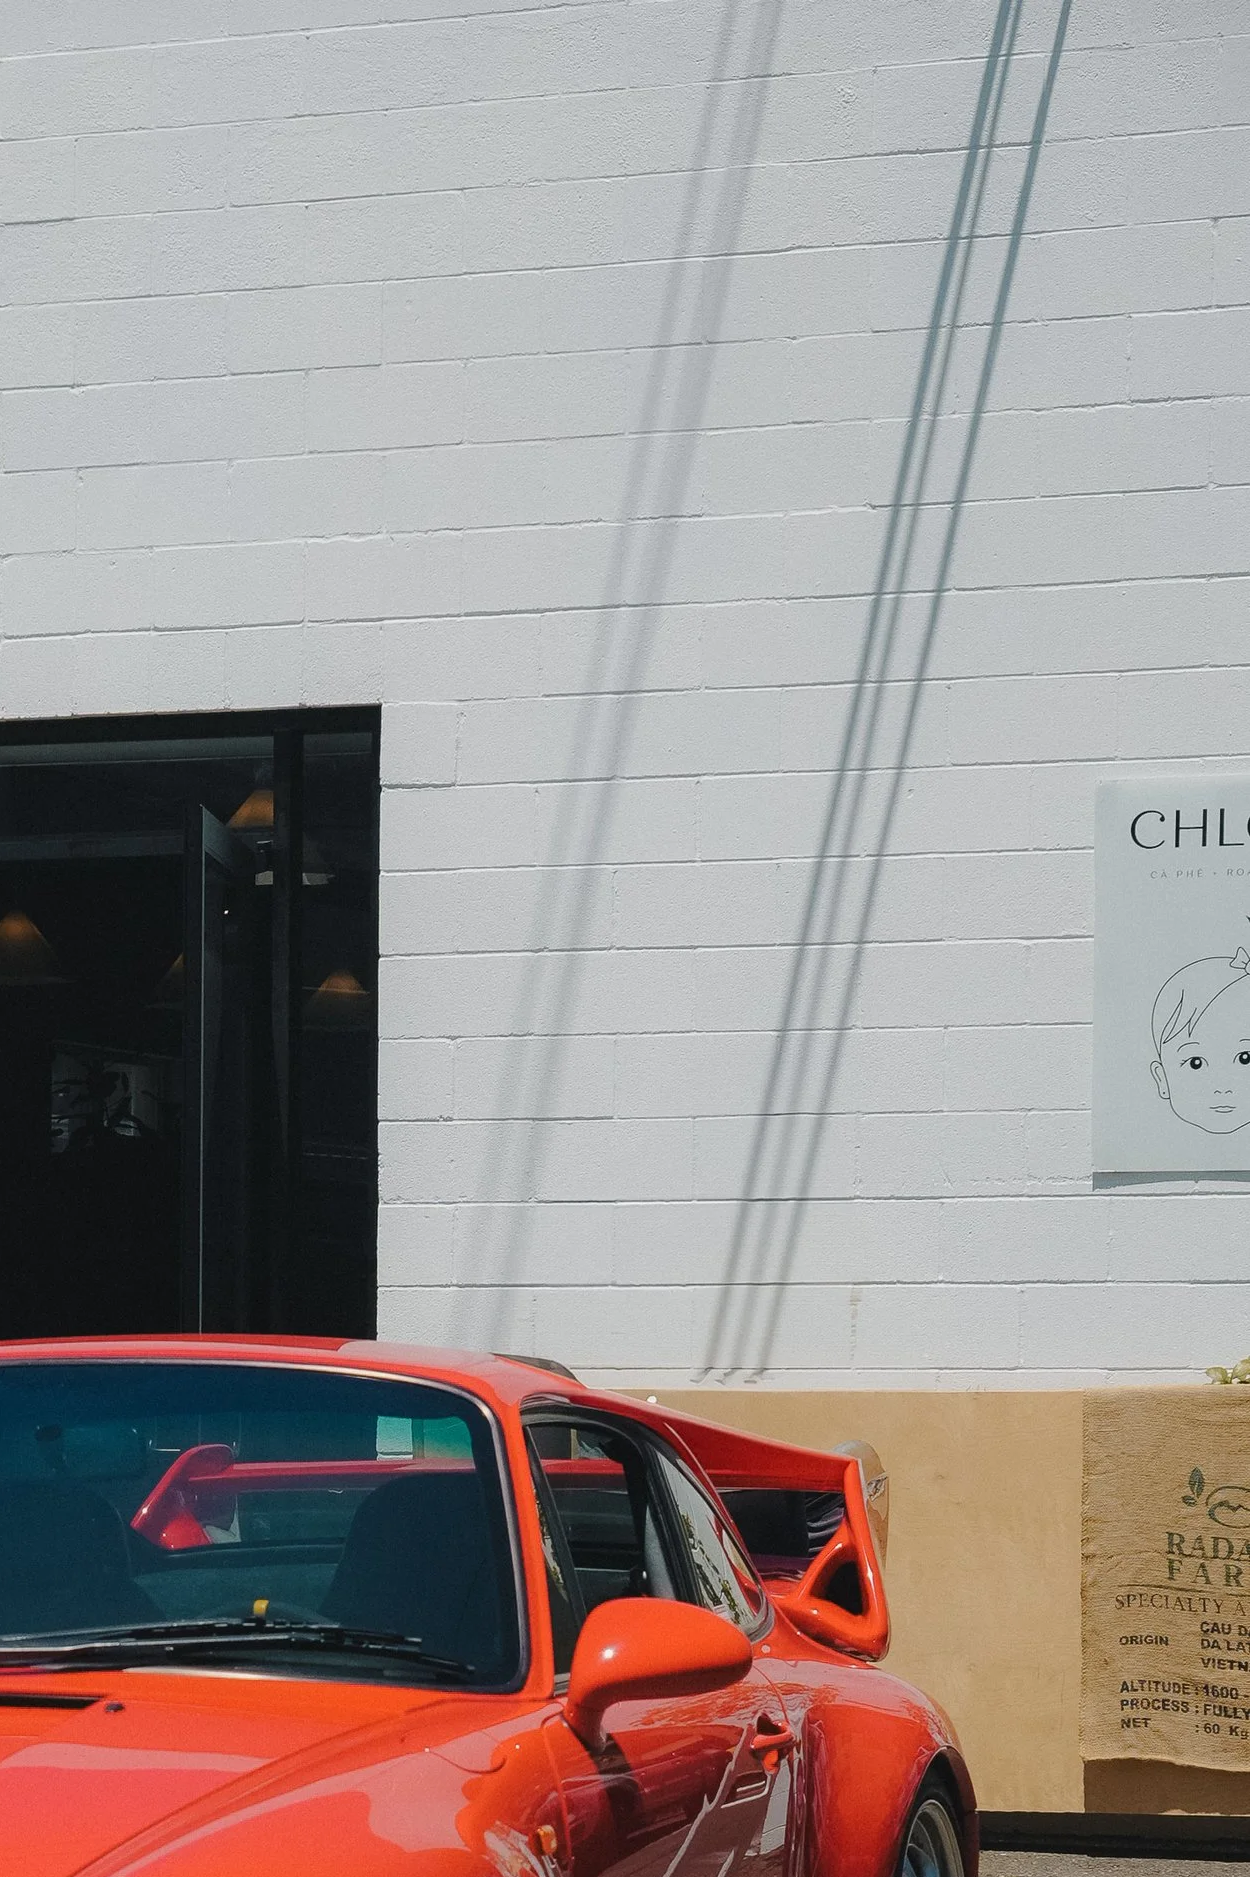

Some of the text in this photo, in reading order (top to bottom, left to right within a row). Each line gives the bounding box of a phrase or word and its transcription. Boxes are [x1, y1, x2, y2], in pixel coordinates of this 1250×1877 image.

[1130, 808, 1250, 849] CHL
[1227, 868, 1250, 877] RO
[1166, 1558, 1244, 1587] FAR
[1115, 1593, 1224, 1614] SPECIALTY
[1119, 1635, 1169, 1646] ORIGIN
[1200, 1638, 1222, 1650] DA
[1201, 1657, 1250, 1672] VIETN
[1203, 1704, 1250, 1720] FULLY
[1121, 1717, 1151, 1729] NET
[1203, 1723, 1220, 1734] 60
